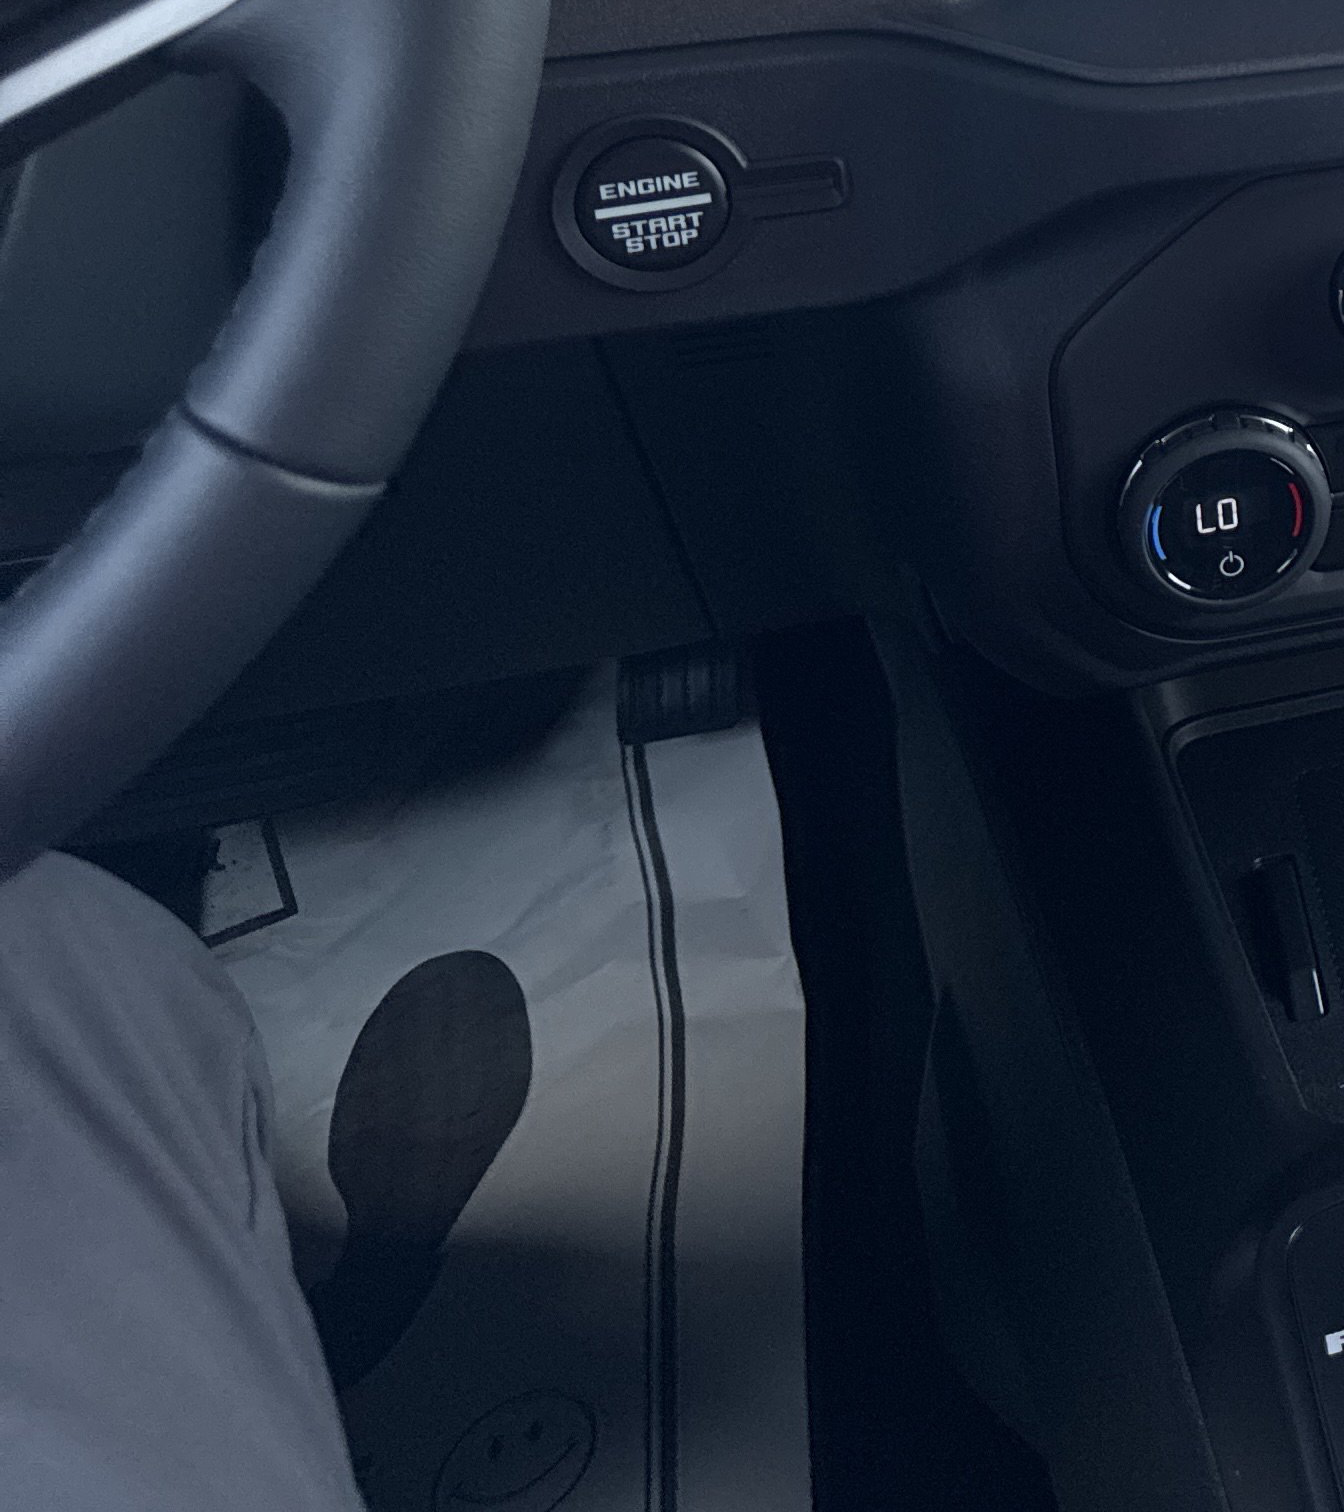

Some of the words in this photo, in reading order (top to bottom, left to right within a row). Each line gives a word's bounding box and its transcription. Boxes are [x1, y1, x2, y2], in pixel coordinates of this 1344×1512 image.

[599, 171, 700, 201] ENGINE
[611, 211, 704, 239] START
[625, 229, 699, 254] STOP
[1196, 497, 1238, 534] LO
